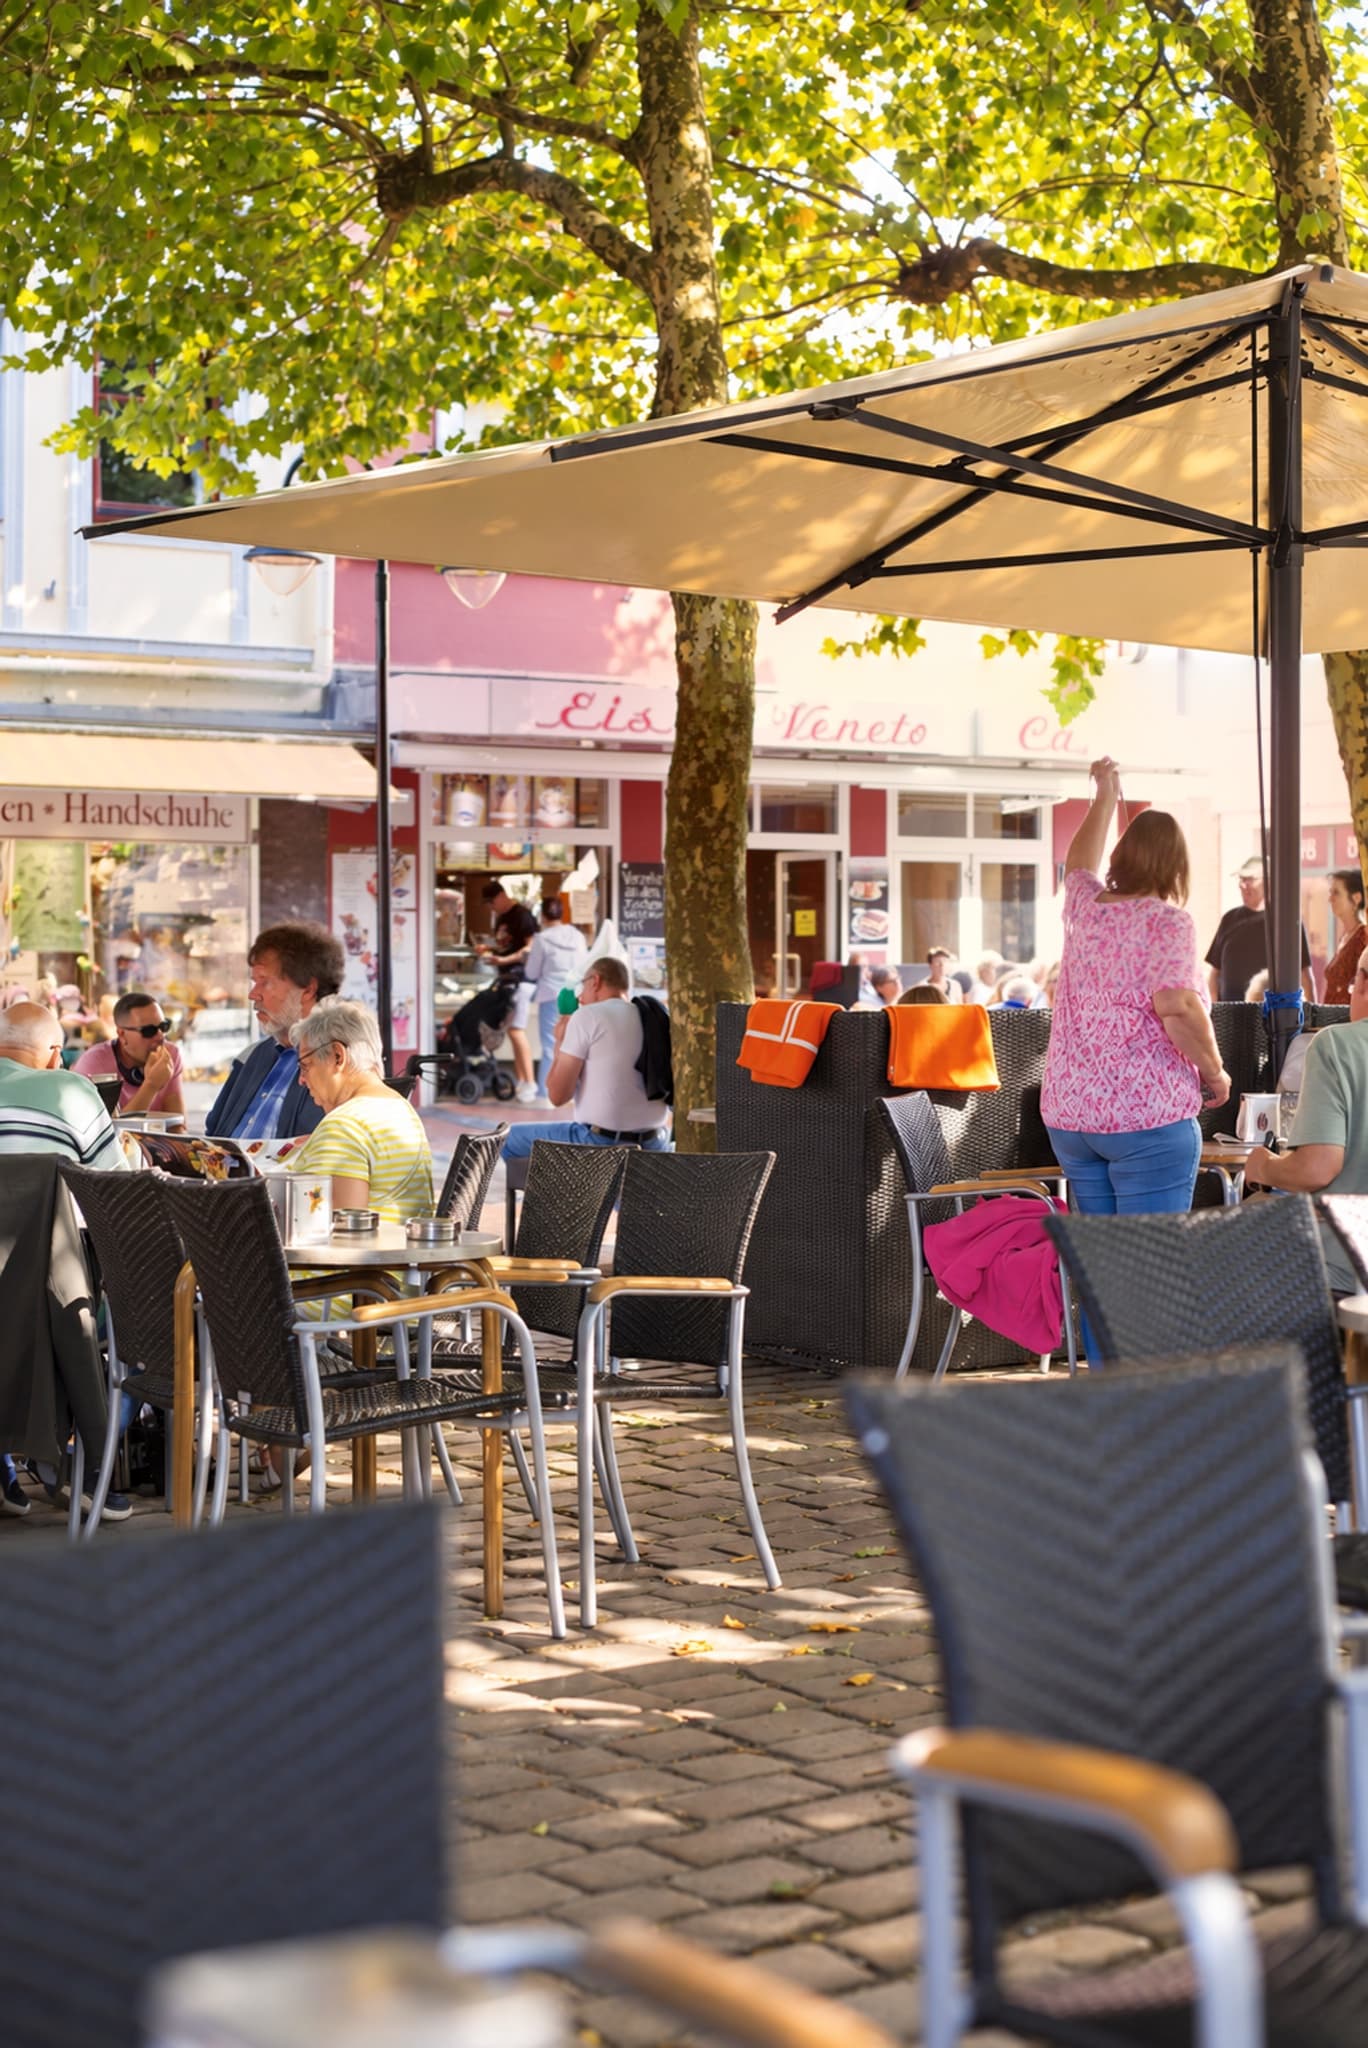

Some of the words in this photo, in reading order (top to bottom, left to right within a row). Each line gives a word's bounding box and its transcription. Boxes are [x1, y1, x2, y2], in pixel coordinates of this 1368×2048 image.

[535, 691, 672, 734] Eis
[772, 701, 927, 745] Veneto
[1018, 715, 1085, 754] Ca
[64, 792, 234, 828] Handschuhe
